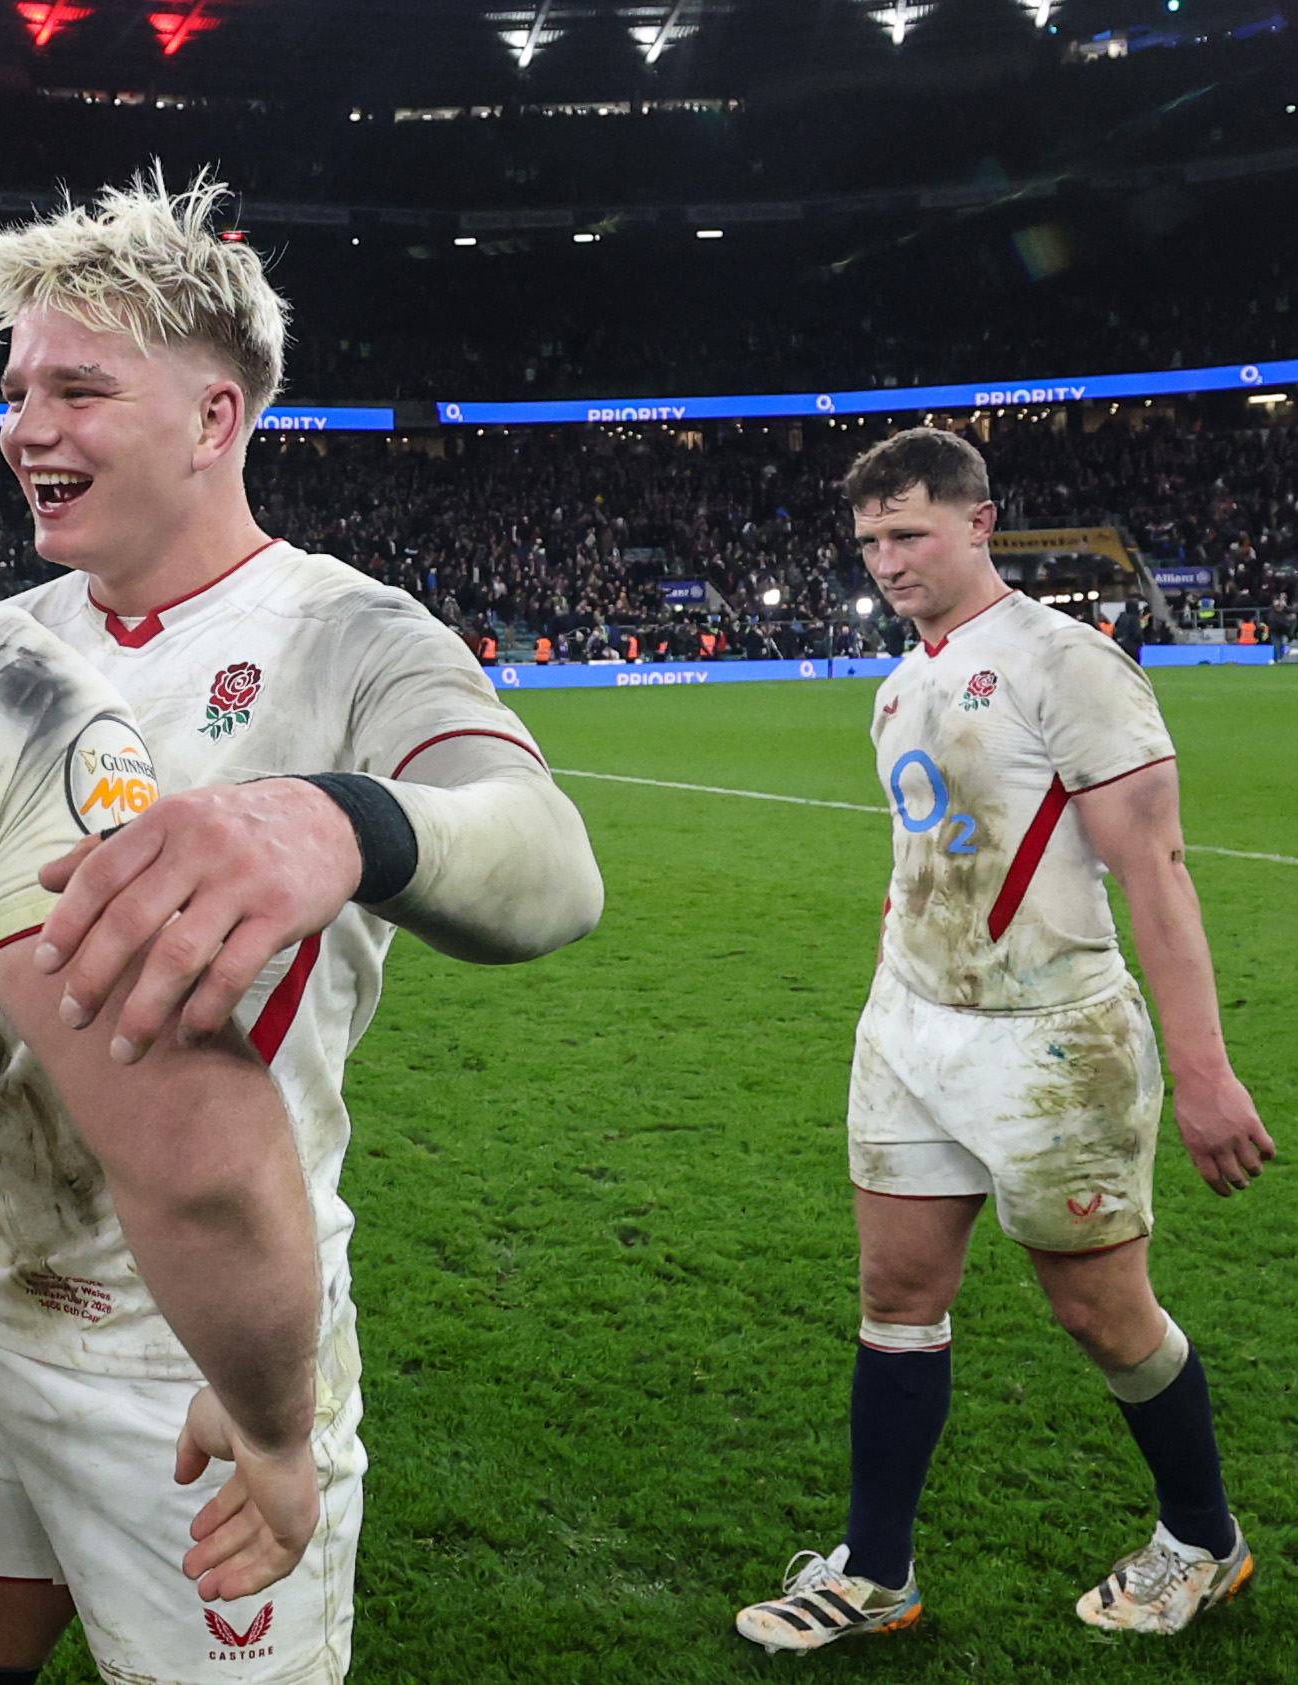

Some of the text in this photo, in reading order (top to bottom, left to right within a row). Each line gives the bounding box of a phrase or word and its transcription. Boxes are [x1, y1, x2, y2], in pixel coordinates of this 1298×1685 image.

[975, 386, 1086, 406] PRIORITY
[587, 406, 686, 422] PRIORITY
[616, 671, 708, 687] PRIORITY
[209, 1645, 274, 1661] CASTORE
